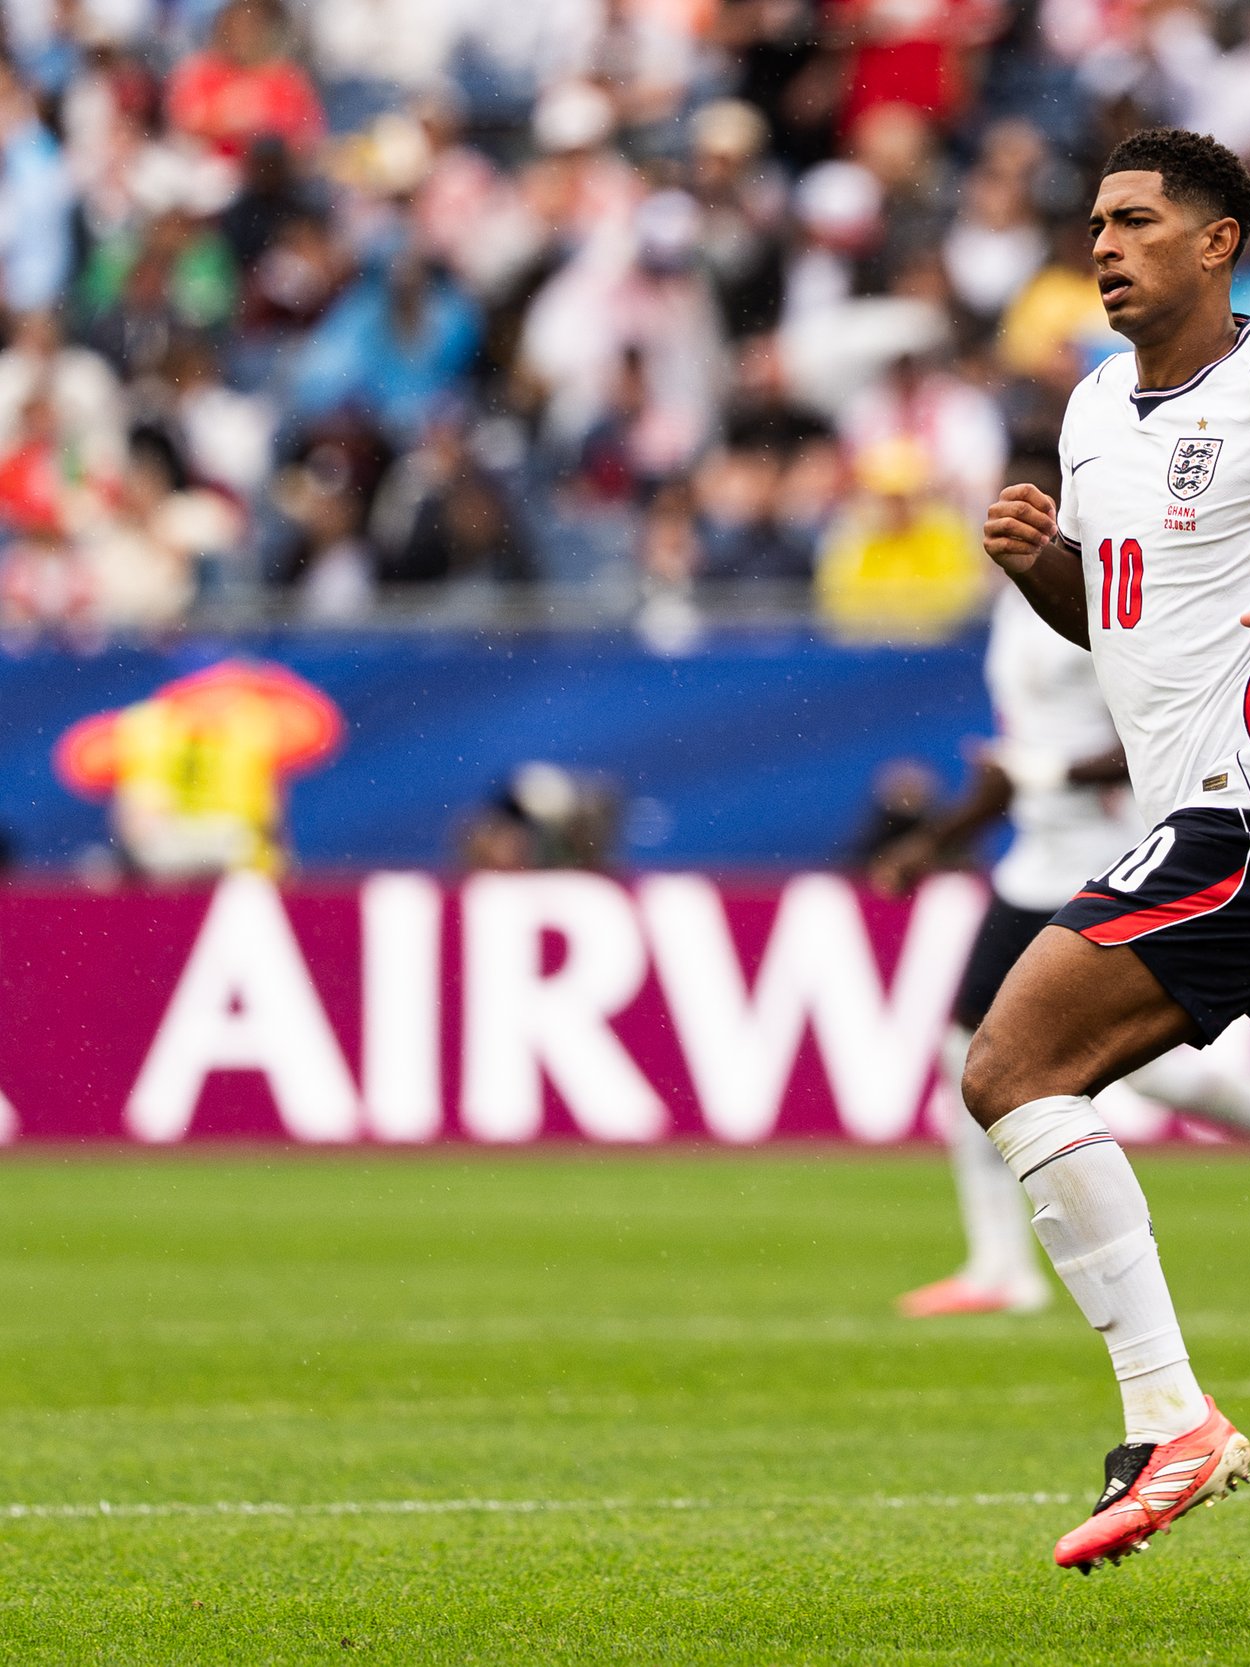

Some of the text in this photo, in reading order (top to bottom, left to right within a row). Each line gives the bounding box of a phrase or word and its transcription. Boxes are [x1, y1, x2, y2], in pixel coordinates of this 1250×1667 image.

[1167, 505, 1196, 518] GHANA
[1164, 518, 1196, 531] 23.06.26
[1098, 538, 1144, 629] 10
